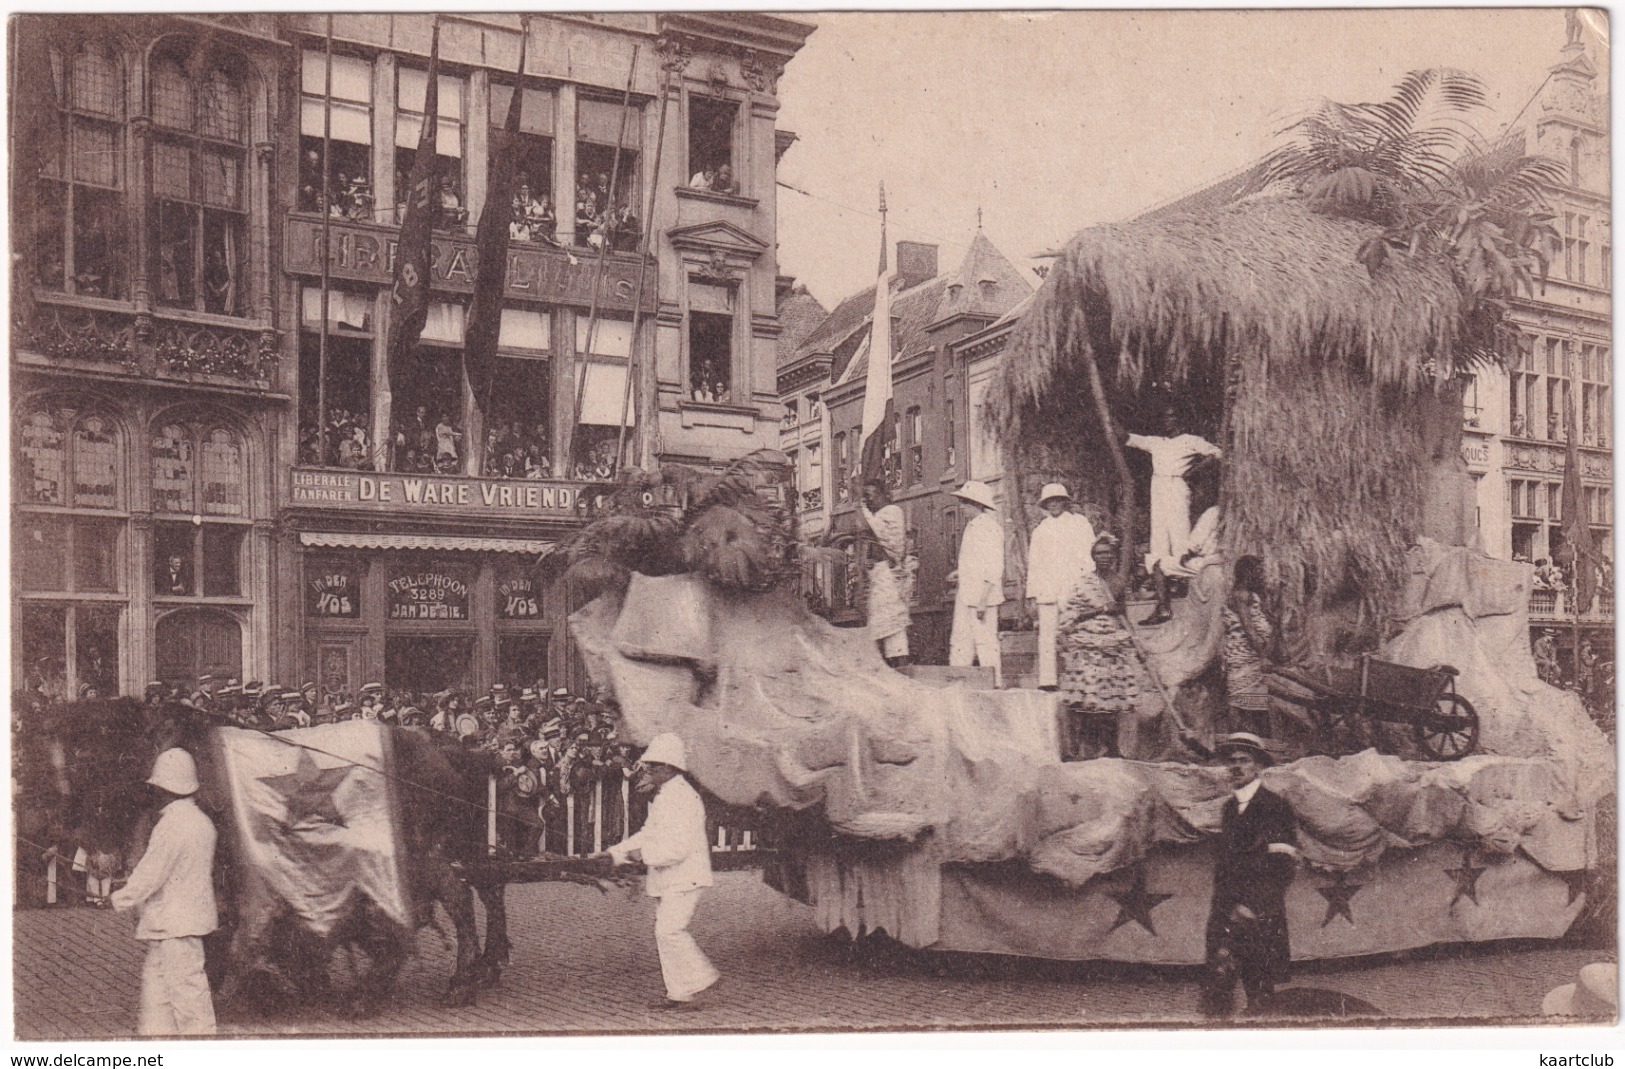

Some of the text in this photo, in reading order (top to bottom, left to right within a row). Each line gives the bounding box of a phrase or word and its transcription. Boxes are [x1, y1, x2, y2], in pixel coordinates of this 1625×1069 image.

[294, 472, 350, 487] LIBERALE
[294, 487, 351, 501] FANFAREN
[358, 477, 391, 501] DE
[402, 479, 469, 505] WARE
[311, 574, 347, 592] IN DEN
[388, 573, 469, 598] TELEPHOON
[499, 580, 532, 596] IN DEN
[315, 592, 352, 614] VOS
[410, 589, 444, 600] 3289
[391, 603, 416, 618] JAN
[419, 604, 436, 618] DE
[504, 596, 539, 616] VOS
